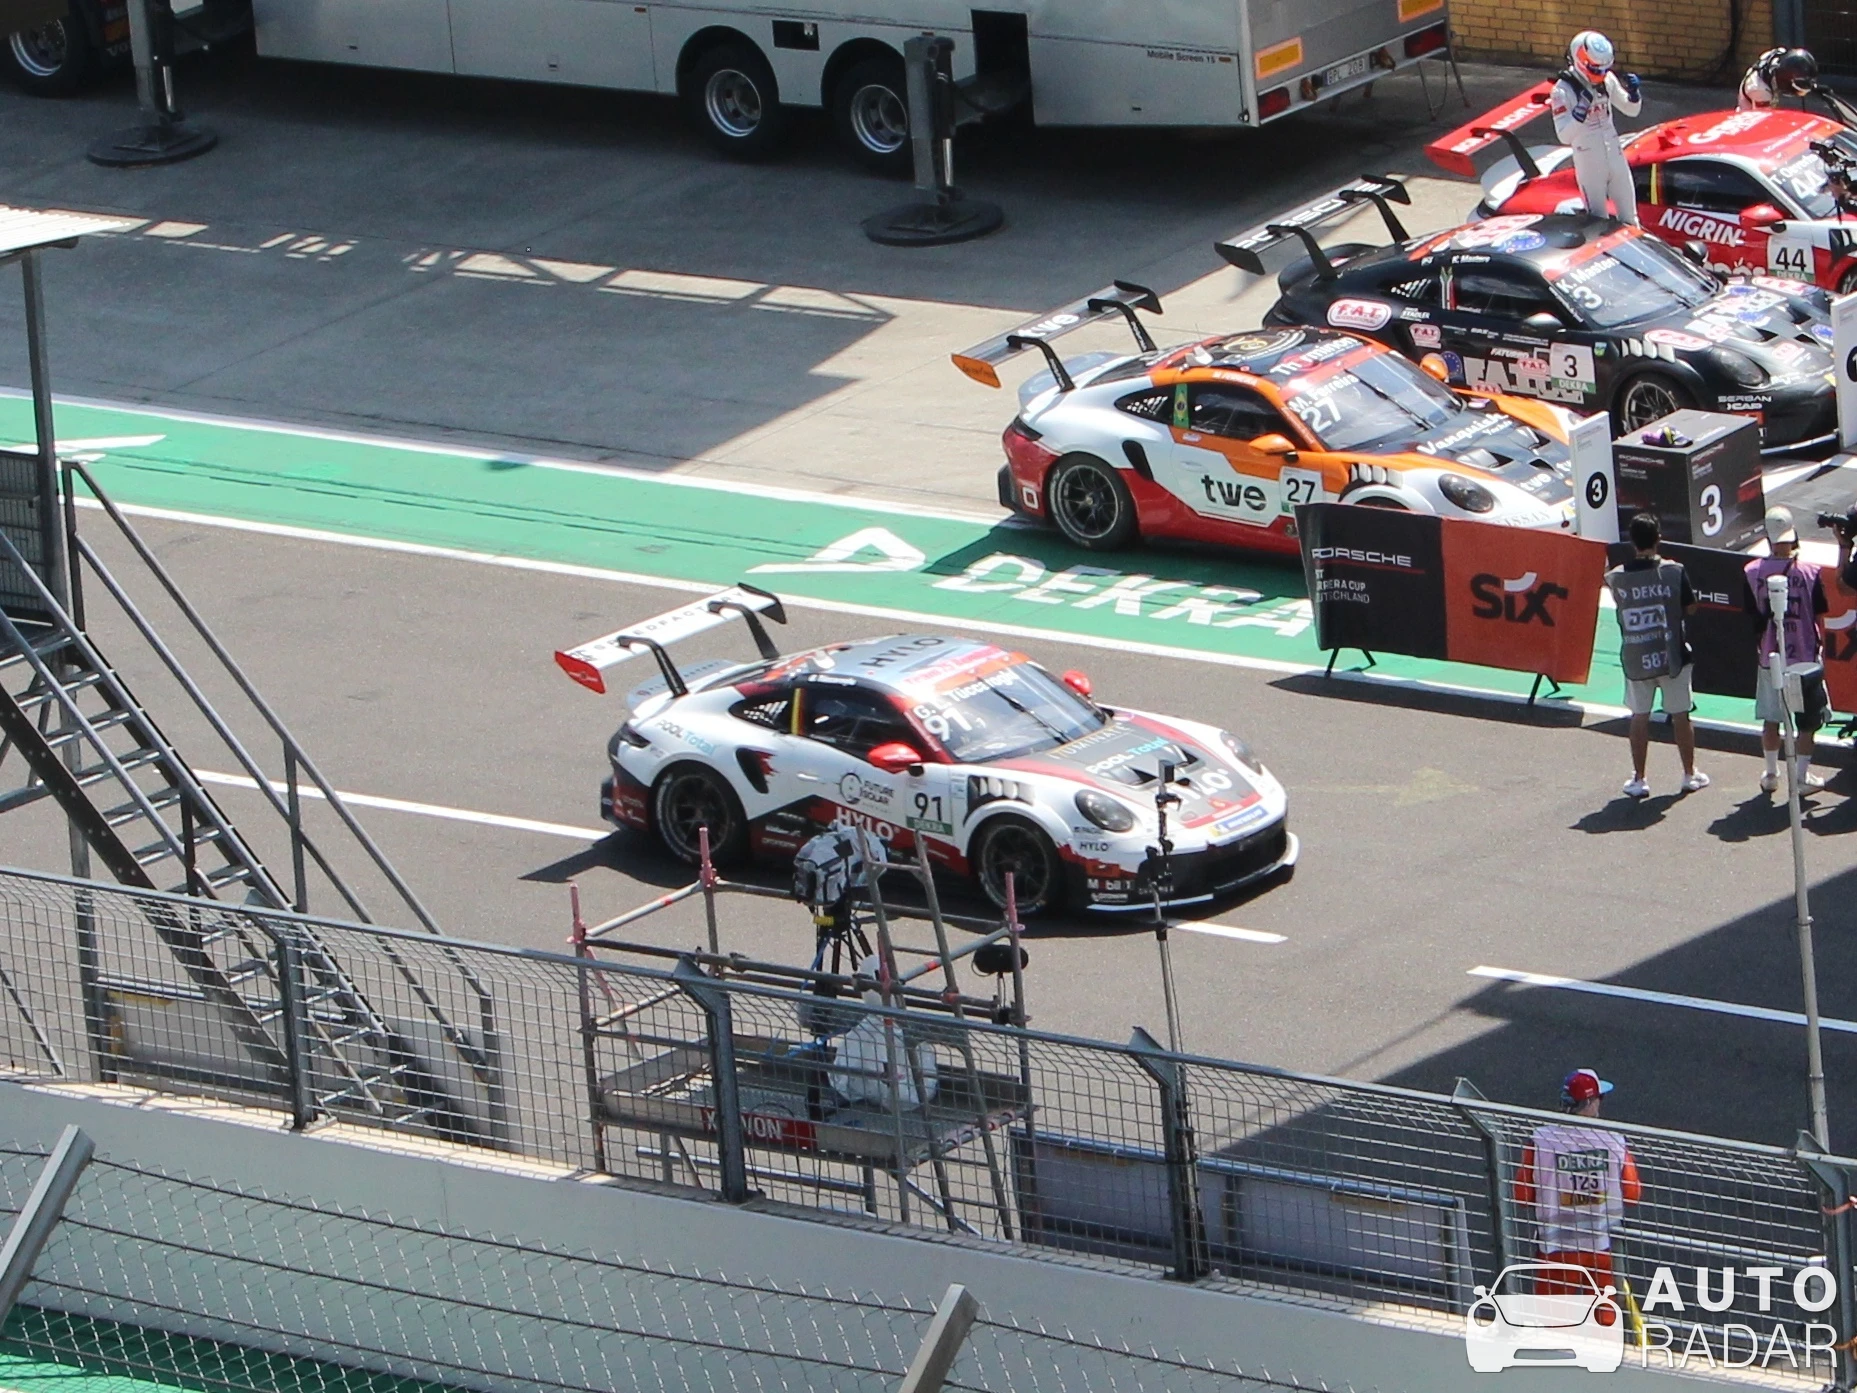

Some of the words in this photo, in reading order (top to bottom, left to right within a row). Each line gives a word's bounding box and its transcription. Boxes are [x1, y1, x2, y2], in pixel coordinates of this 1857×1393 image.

[1147, 50, 1174, 61] Mobile
[1176, 53, 1204, 63] Screen
[1659, 208, 1742, 248] NIGRIN
[1776, 246, 1807, 272] 44
[1573, 285, 1603, 310] 3
[1563, 354, 1578, 378] 3
[1558, 379, 1590, 393] DEKRA
[1300, 397, 1342, 433] 27
[1200, 474, 1269, 512] twe
[1286, 478, 1317, 504] 27
[1591, 478, 1603, 502] 3
[1700, 483, 1725, 537] 3
[1348, 580, 1366, 591] CUP
[922, 707, 973, 742] 91
[914, 792, 942, 822] 91
[835, 806, 895, 842] HYLO
[1080, 841, 1109, 852] HYLO
[1569, 1171, 1599, 1191] 123
